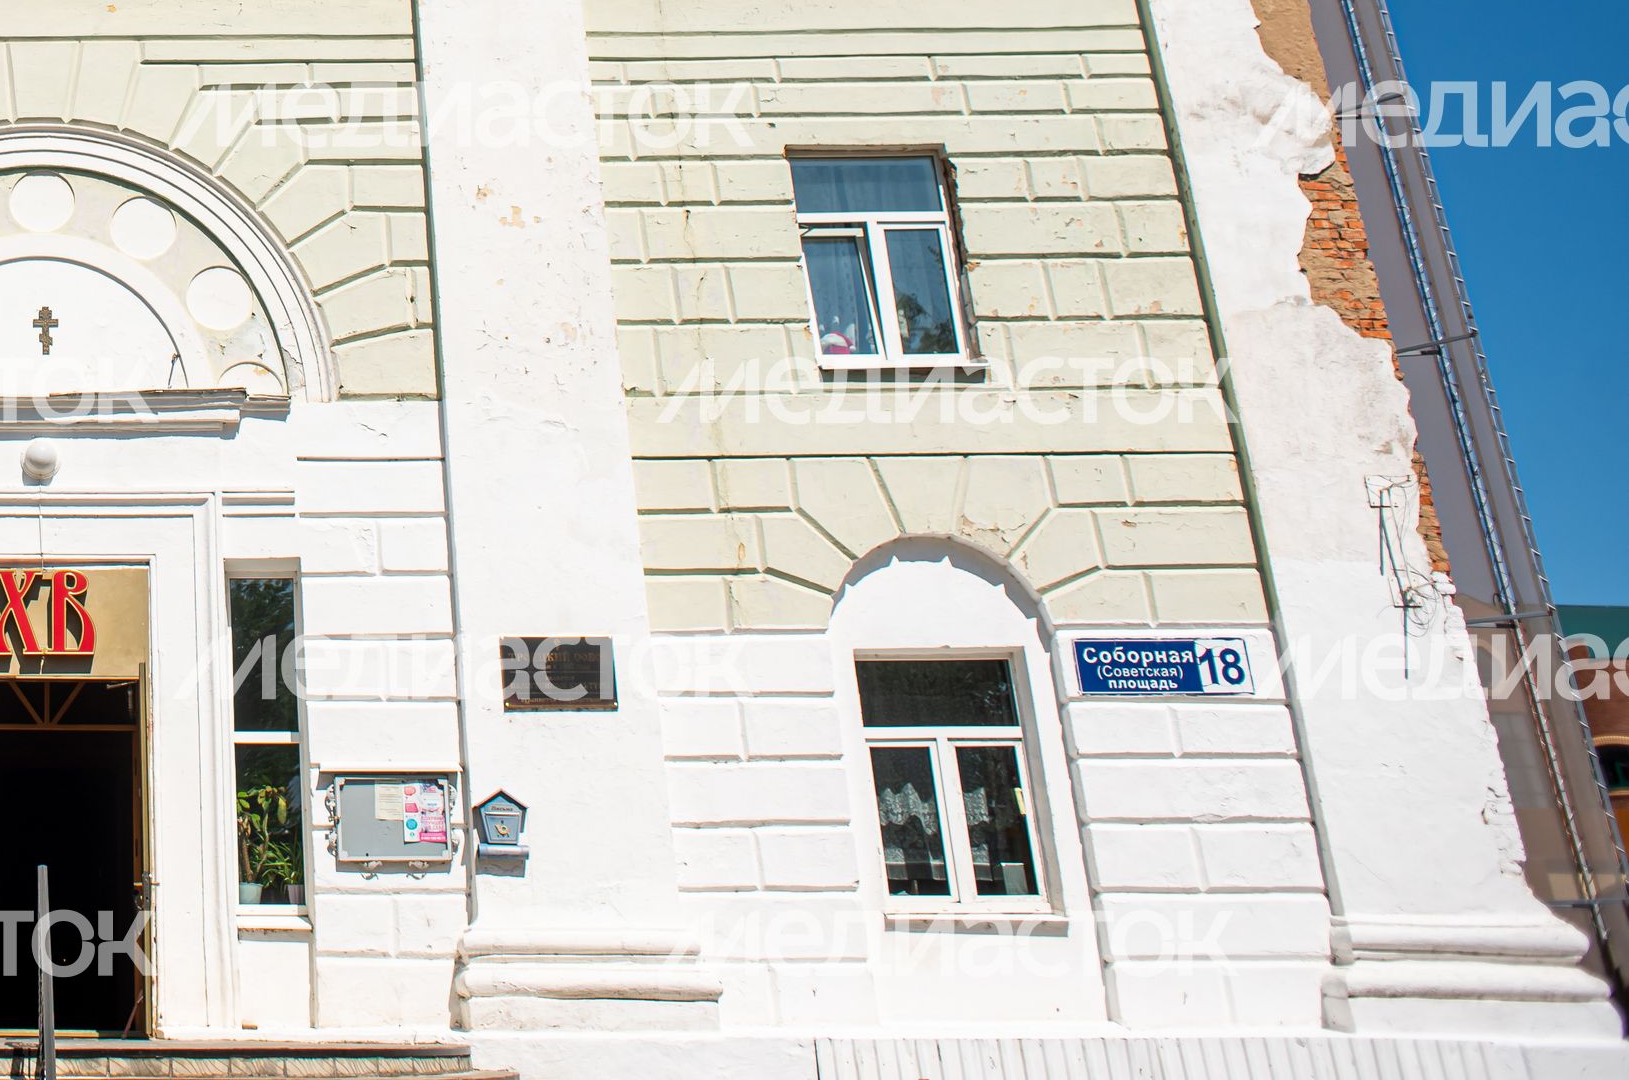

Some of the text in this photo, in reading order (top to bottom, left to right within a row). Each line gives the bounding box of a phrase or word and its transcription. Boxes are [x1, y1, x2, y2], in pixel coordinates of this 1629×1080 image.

[1082, 646, 1246, 686] Соборная 18
[1096, 665, 1184, 680] (Советская)
[1108, 679, 1179, 691] площадь
